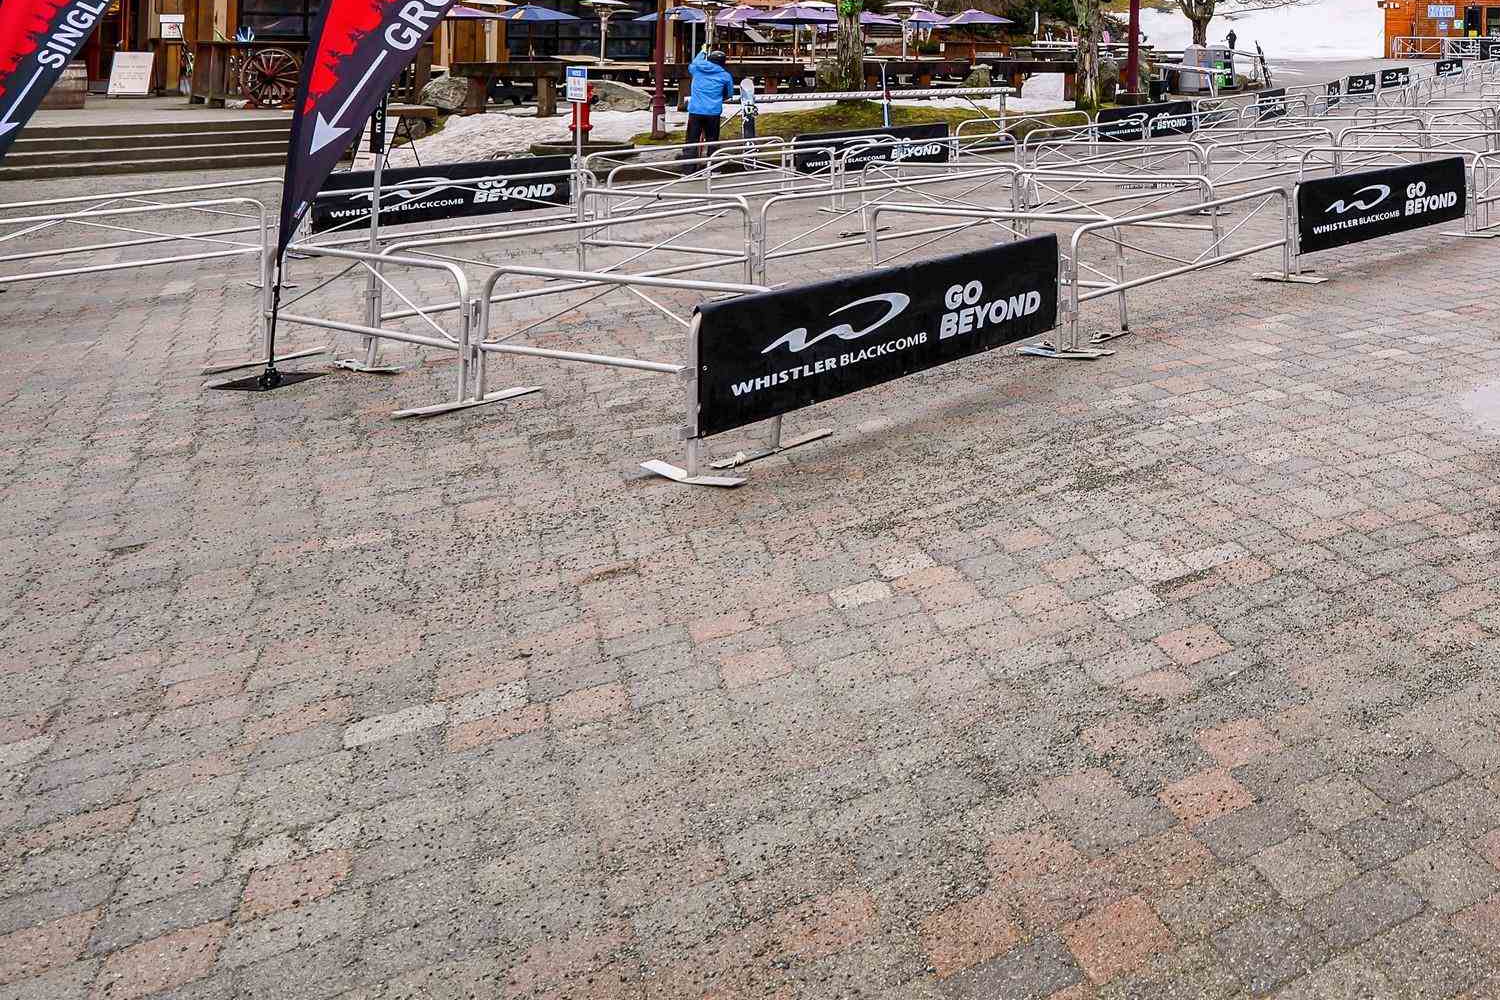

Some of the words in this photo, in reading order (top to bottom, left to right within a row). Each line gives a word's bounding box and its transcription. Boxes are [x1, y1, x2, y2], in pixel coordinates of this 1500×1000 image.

[1157, 118, 1187, 130] BEYOND
[473, 183, 556, 203] BEYOND
[1406, 181, 1427, 199] GO
[330, 204, 400, 218] WHISTER
[401, 198, 464, 211] BLACKCOMB
[1404, 191, 1458, 217] BEYOND
[1313, 219, 1359, 235] WHISTLER
[1359, 210, 1400, 225] BLACKCOMB
[944, 280, 983, 310] GO
[939, 290, 1041, 340] BEYOND
[731, 357, 838, 397] WHISTLER
[840, 331, 928, 366] BLACKCOMB
